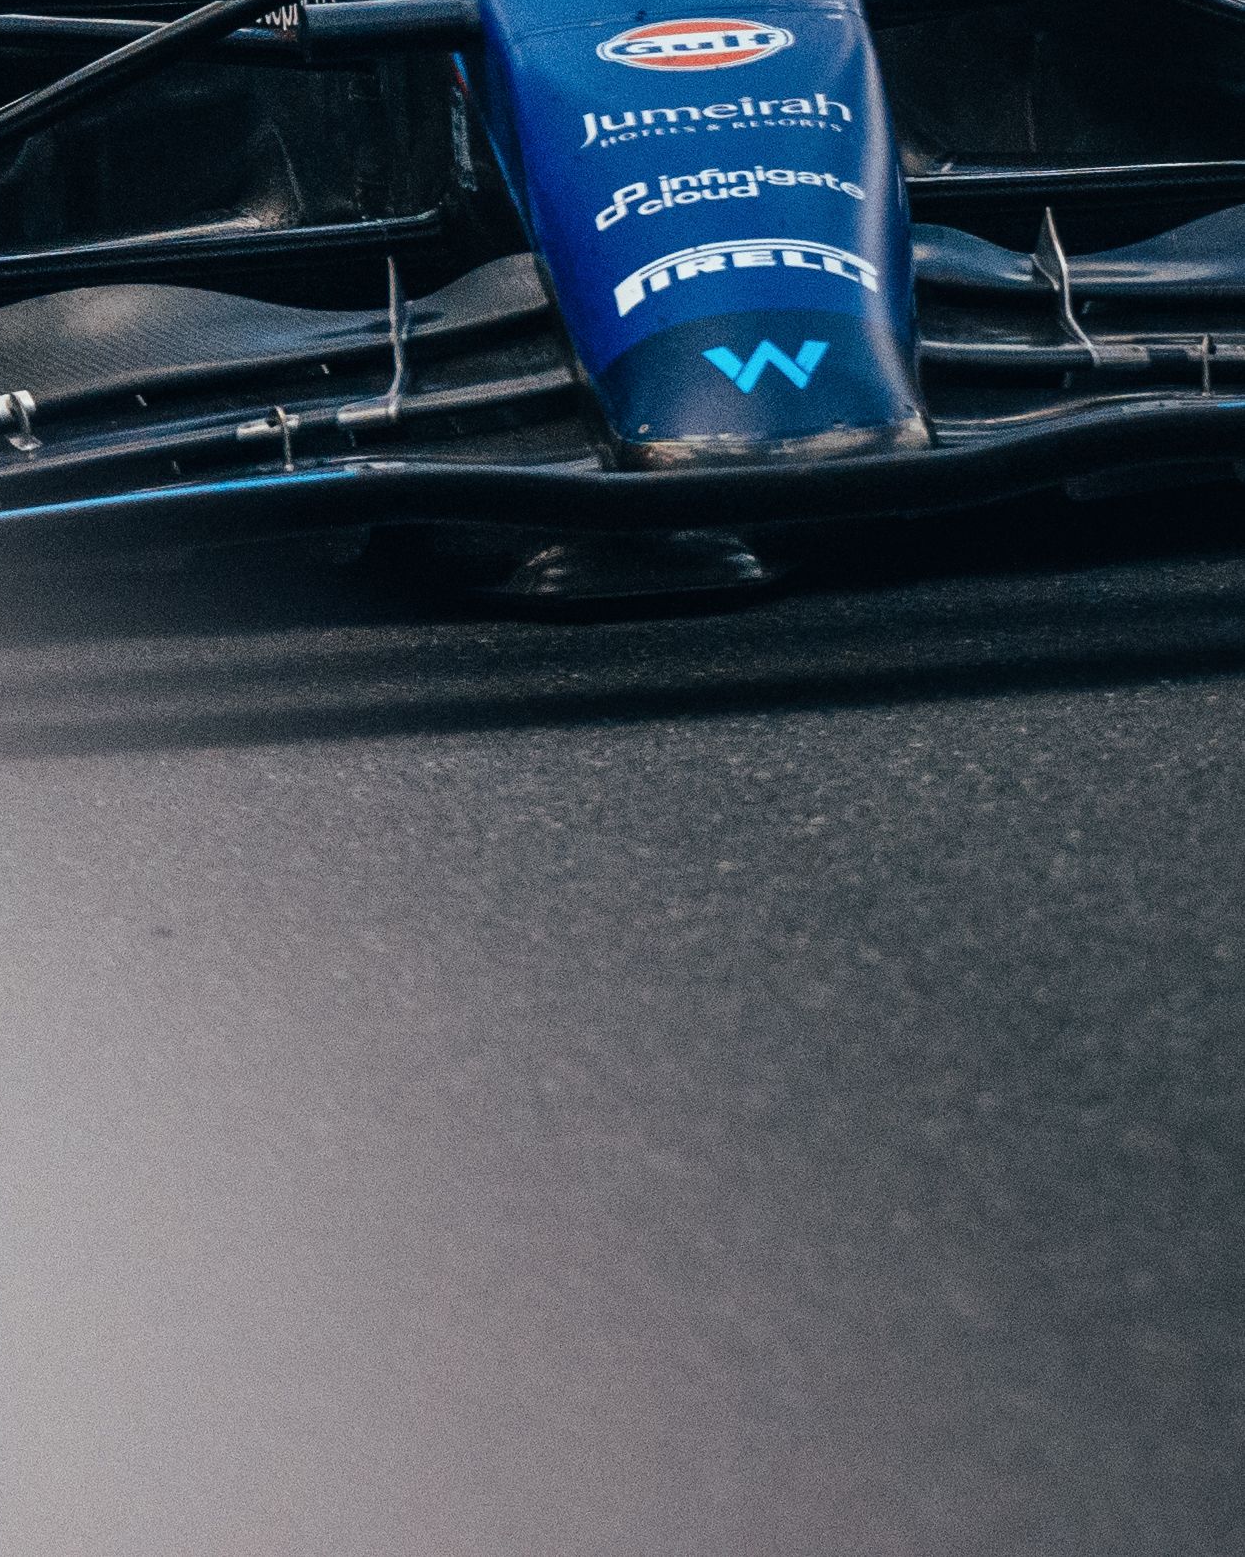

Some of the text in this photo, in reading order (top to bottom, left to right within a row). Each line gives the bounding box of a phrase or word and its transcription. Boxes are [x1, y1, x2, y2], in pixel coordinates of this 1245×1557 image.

[616, 30, 778, 58] Gulf
[580, 92, 853, 149] Jumeirah
[599, 125, 696, 148] HOTELS
[732, 119, 845, 133] RESORTS
[637, 180, 759, 216] cloud
[660, 166, 866, 200] infinigate
[615, 238, 878, 317] PIRELLI
